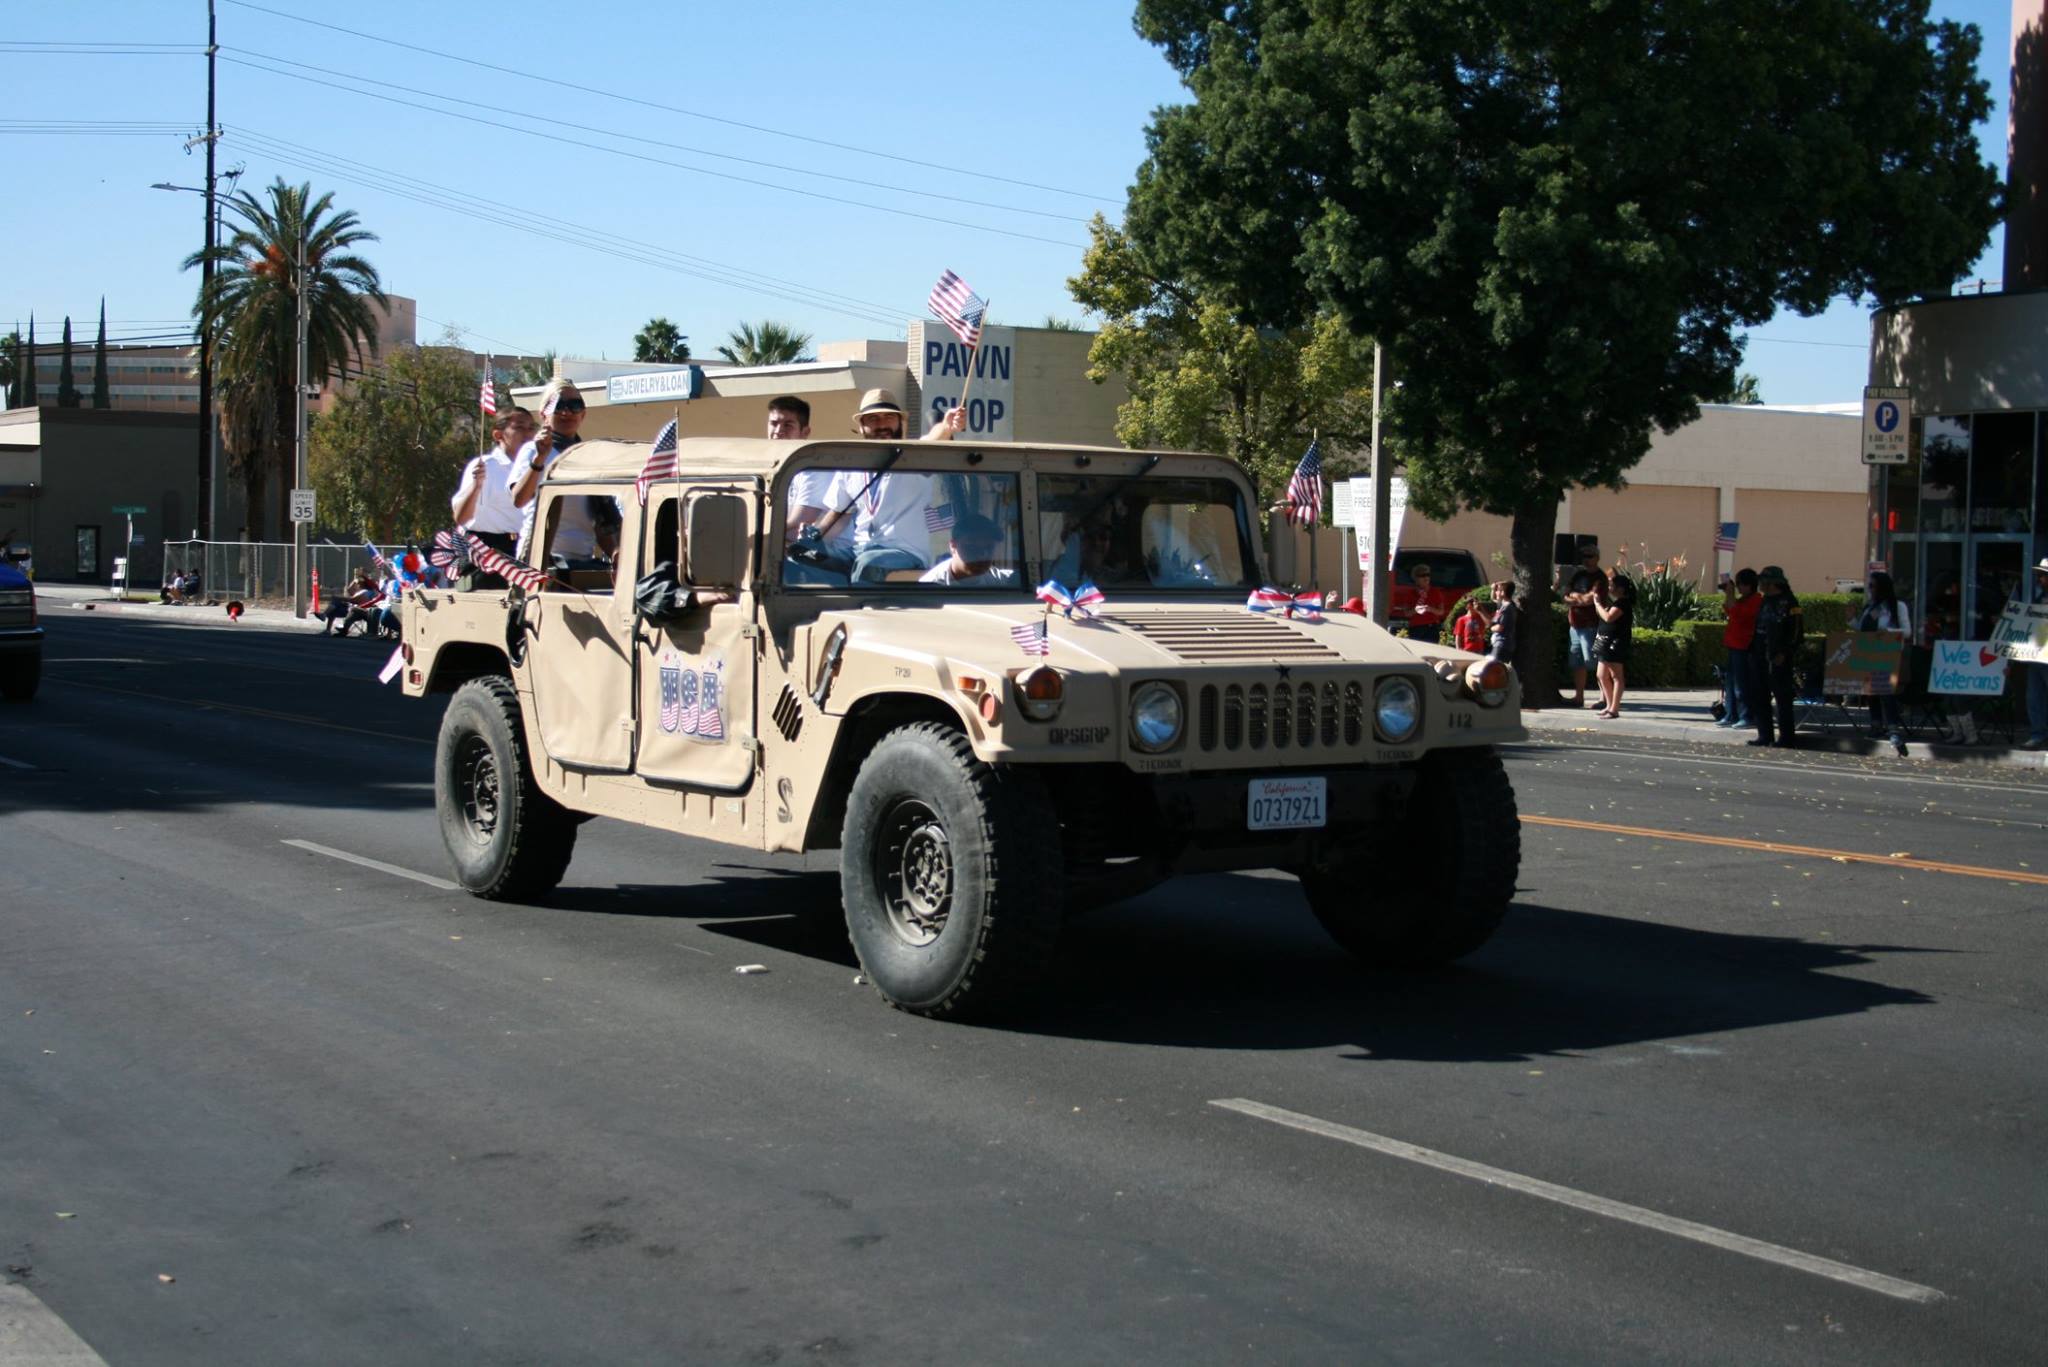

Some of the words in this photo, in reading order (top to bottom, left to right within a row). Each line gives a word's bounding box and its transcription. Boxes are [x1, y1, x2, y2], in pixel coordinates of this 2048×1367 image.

[925, 340, 1010, 379] PAWN
[294, 506, 313, 519] 35
[1995, 617, 2033, 644] Thank
[1942, 643, 1971, 665] We
[1933, 667, 2001, 692] Veterans
[659, 666, 724, 740] USA
[1448, 711, 1473, 729] 112
